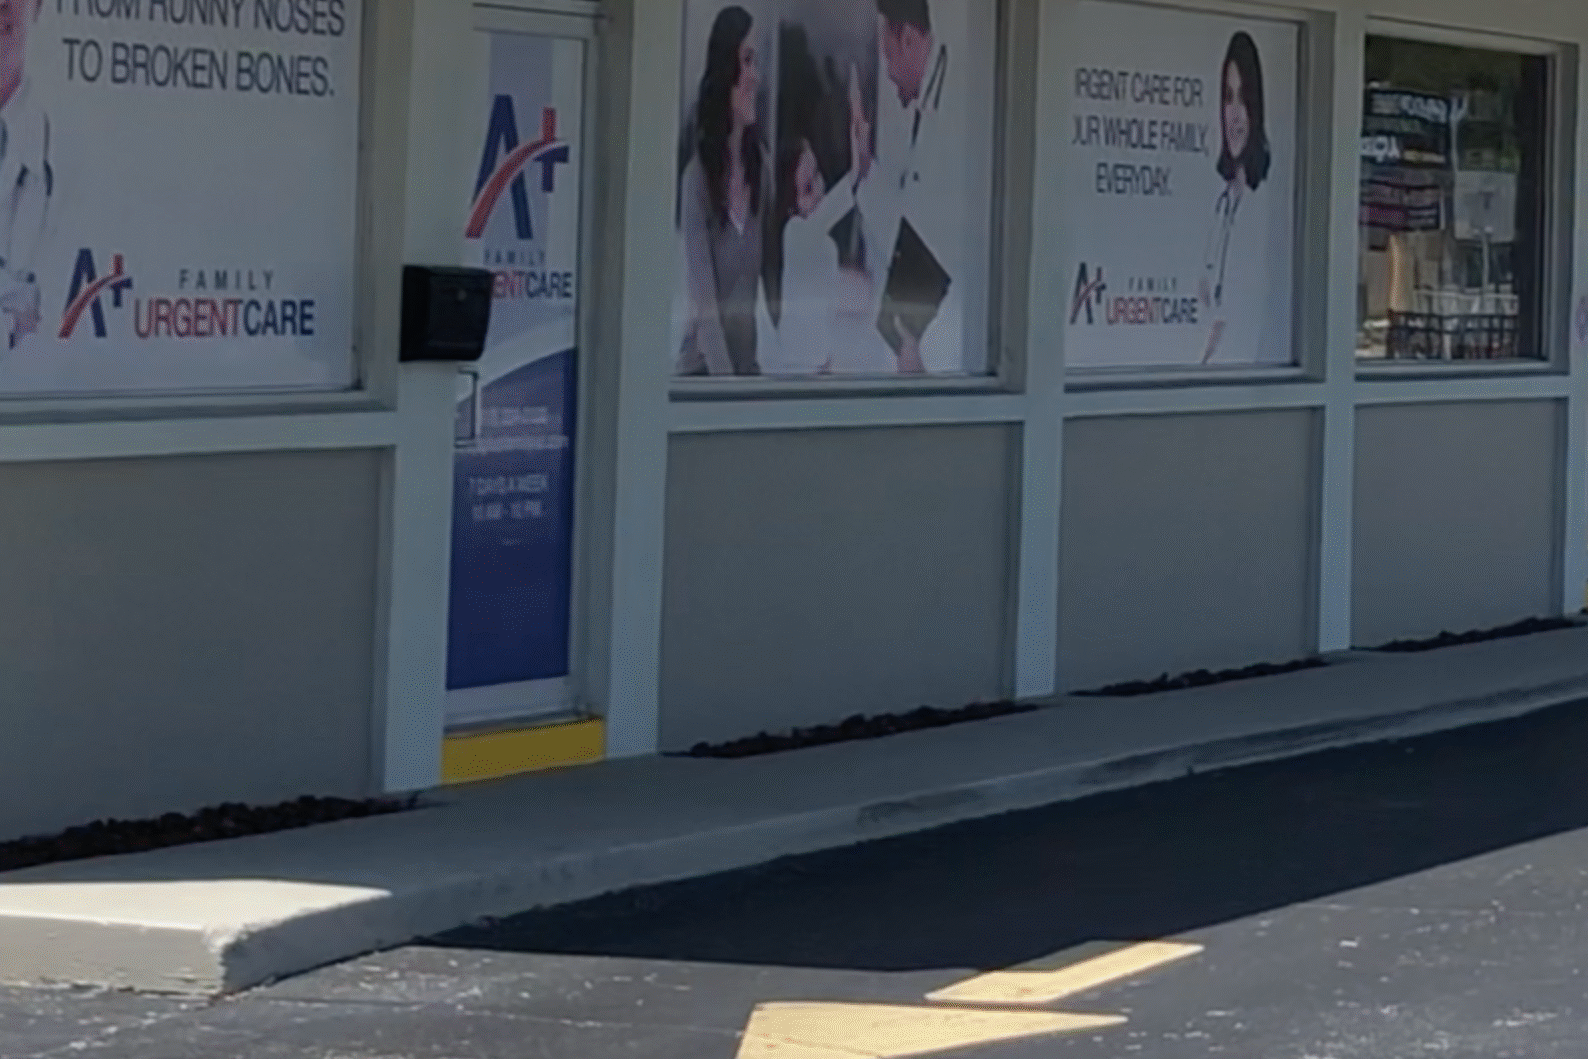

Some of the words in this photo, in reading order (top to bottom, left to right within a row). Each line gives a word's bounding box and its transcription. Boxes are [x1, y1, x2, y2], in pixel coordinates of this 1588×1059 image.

[63, 39, 104, 81] TO
[111, 42, 228, 90] BROKEN
[235, 51, 336, 97] BONES.
[1132, 72, 1171, 106] CARE
[1174, 76, 1204, 107] FOR
[1103, 116, 1158, 150] WHOLE
[179, 269, 274, 291] FAMILY
[133, 299, 315, 338] URGENTCARE
